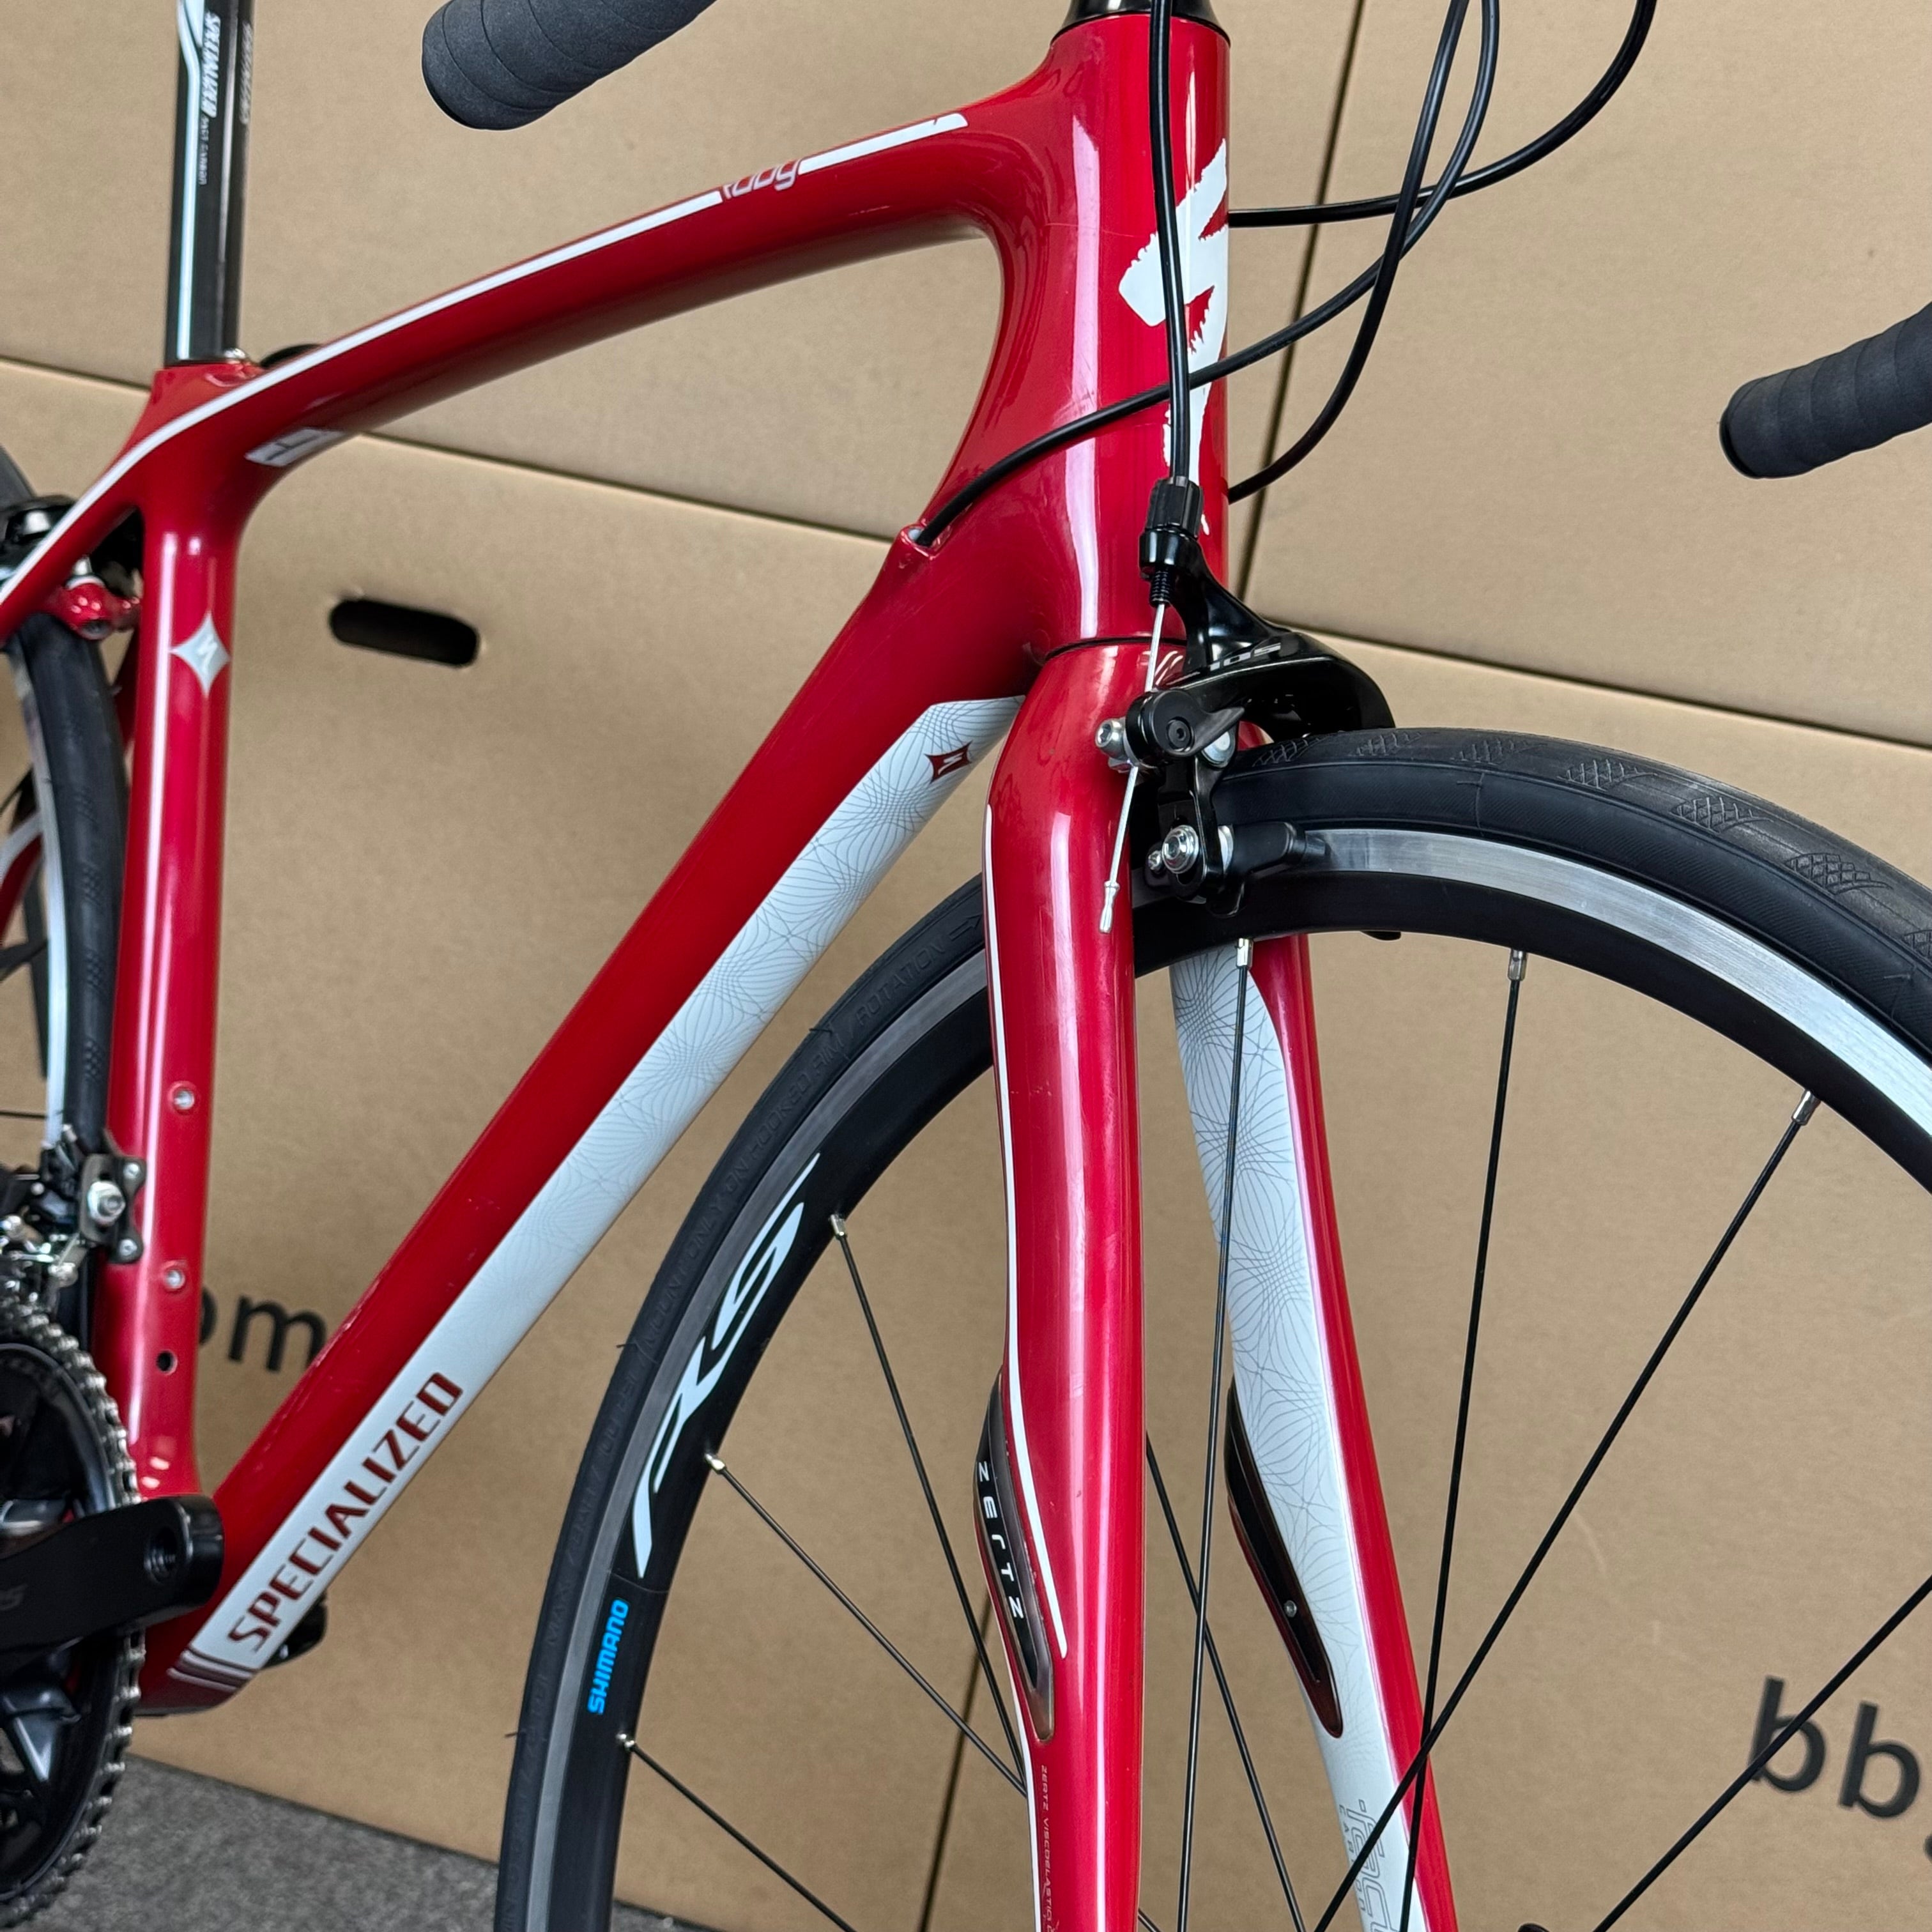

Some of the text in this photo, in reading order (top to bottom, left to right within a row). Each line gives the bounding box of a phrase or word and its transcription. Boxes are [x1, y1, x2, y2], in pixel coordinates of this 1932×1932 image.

[854, 935, 949, 1026] ROTATION
[227, 1372, 464, 1652] SPECIALIZED
[586, 1598, 629, 1715] SHIMANO
[1041, 1765, 1050, 1811] ZERTZ
[1747, 1675, 1932, 1863] bb
[1338, 1804, 1366, 1912] CARON
